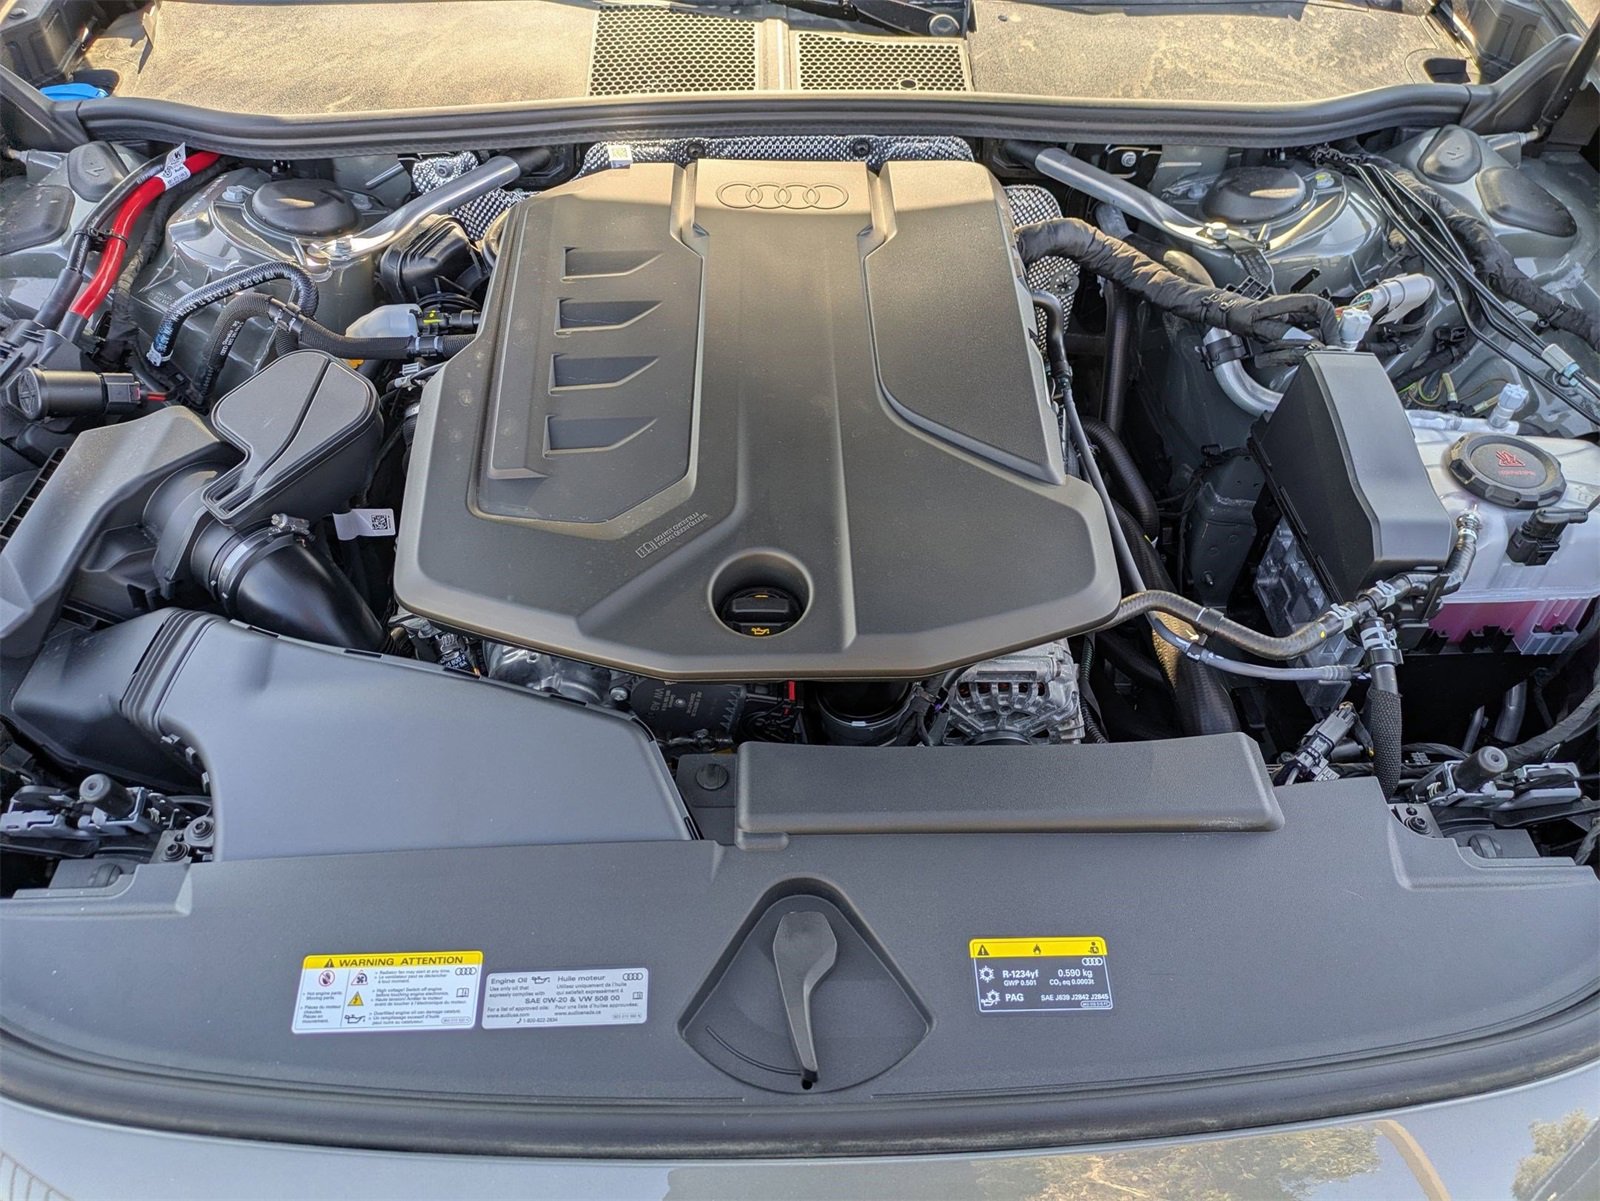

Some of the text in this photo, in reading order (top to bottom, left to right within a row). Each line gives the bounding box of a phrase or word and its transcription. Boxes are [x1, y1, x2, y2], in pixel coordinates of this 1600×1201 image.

[339, 956, 463, 966] WARNING ATTENTION
[1002, 969, 1039, 979] R-1234yf
[1082, 969, 1093, 978] kg
